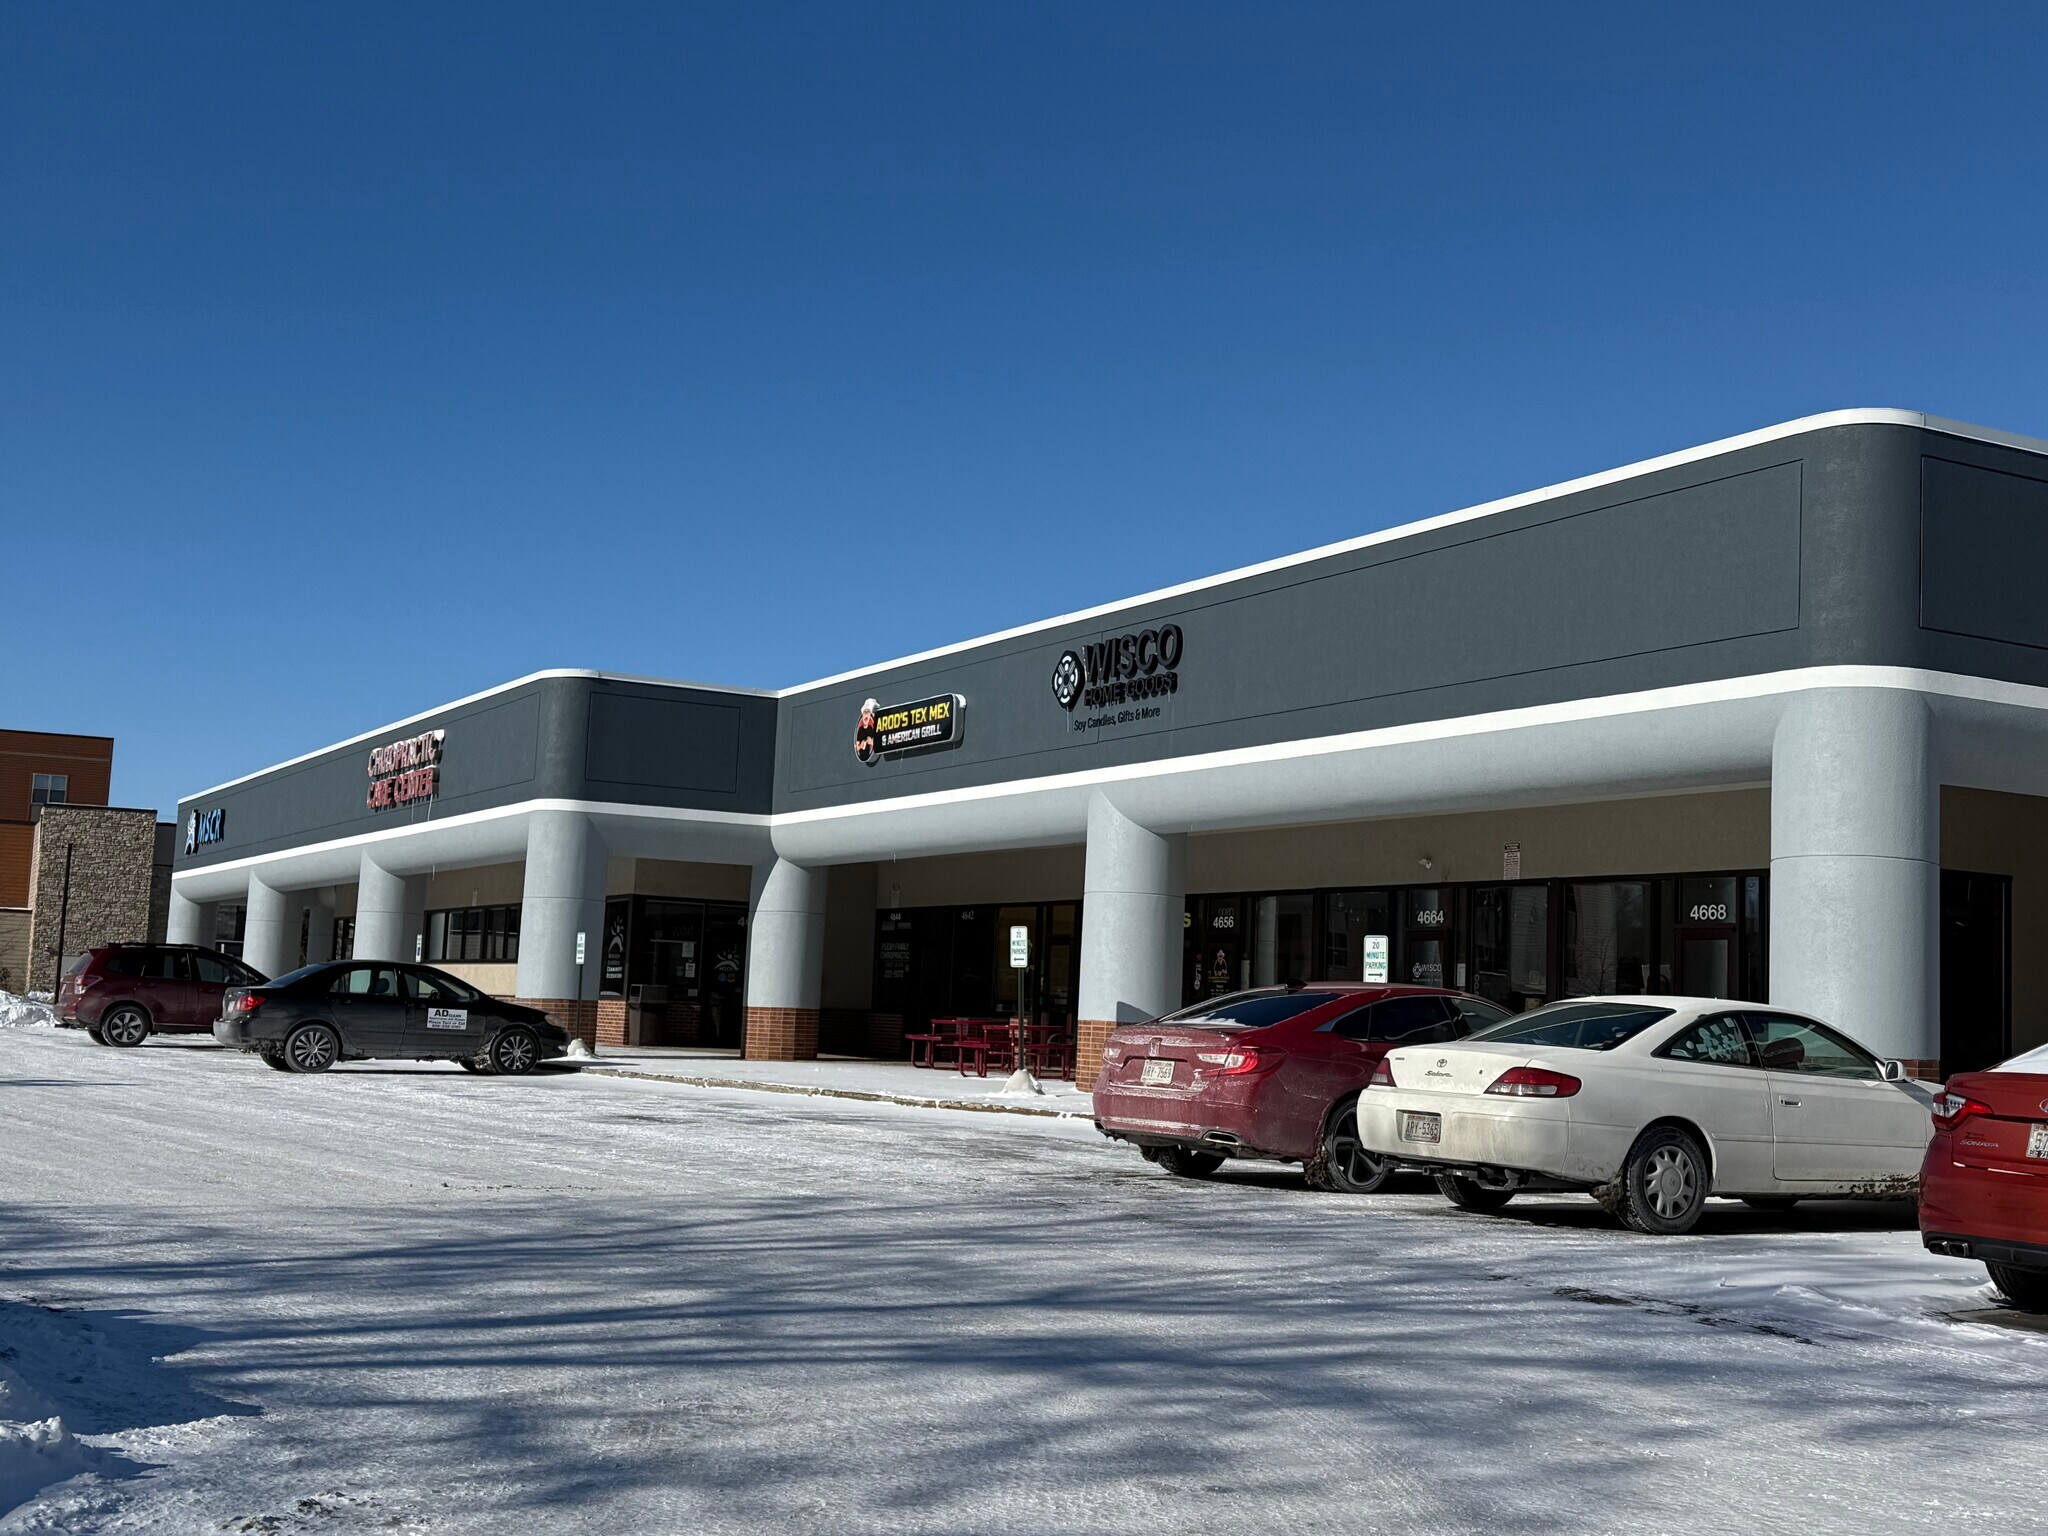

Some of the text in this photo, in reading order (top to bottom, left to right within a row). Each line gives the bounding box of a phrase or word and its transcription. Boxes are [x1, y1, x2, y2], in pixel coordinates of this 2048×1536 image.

[1083, 624, 1181, 685] WISCO
[1084, 671, 1177, 706] HOME GOODS
[876, 702, 950, 732] AROD'S TEX MEX
[1074, 707, 1160, 732] Soy Candles, Gifts & More
[882, 724, 942, 746] & AMERICAN GRILL
[368, 731, 437, 777] CHIROPRACTIC
[367, 767, 435, 809] CARE CENTER
[198, 809, 222, 844] MSCR
[1417, 910, 1444, 924] 4664
[1690, 904, 1727, 920] 4668
[1213, 916, 1235, 928] 4656
[1372, 941, 1380, 949] 20
[1366, 951, 1385, 960] MINUTE
[1365, 961, 1386, 970] PARKING
[1421, 964, 1442, 972] WISCO
[1406, 1121, 1439, 1136] ARY-5365
